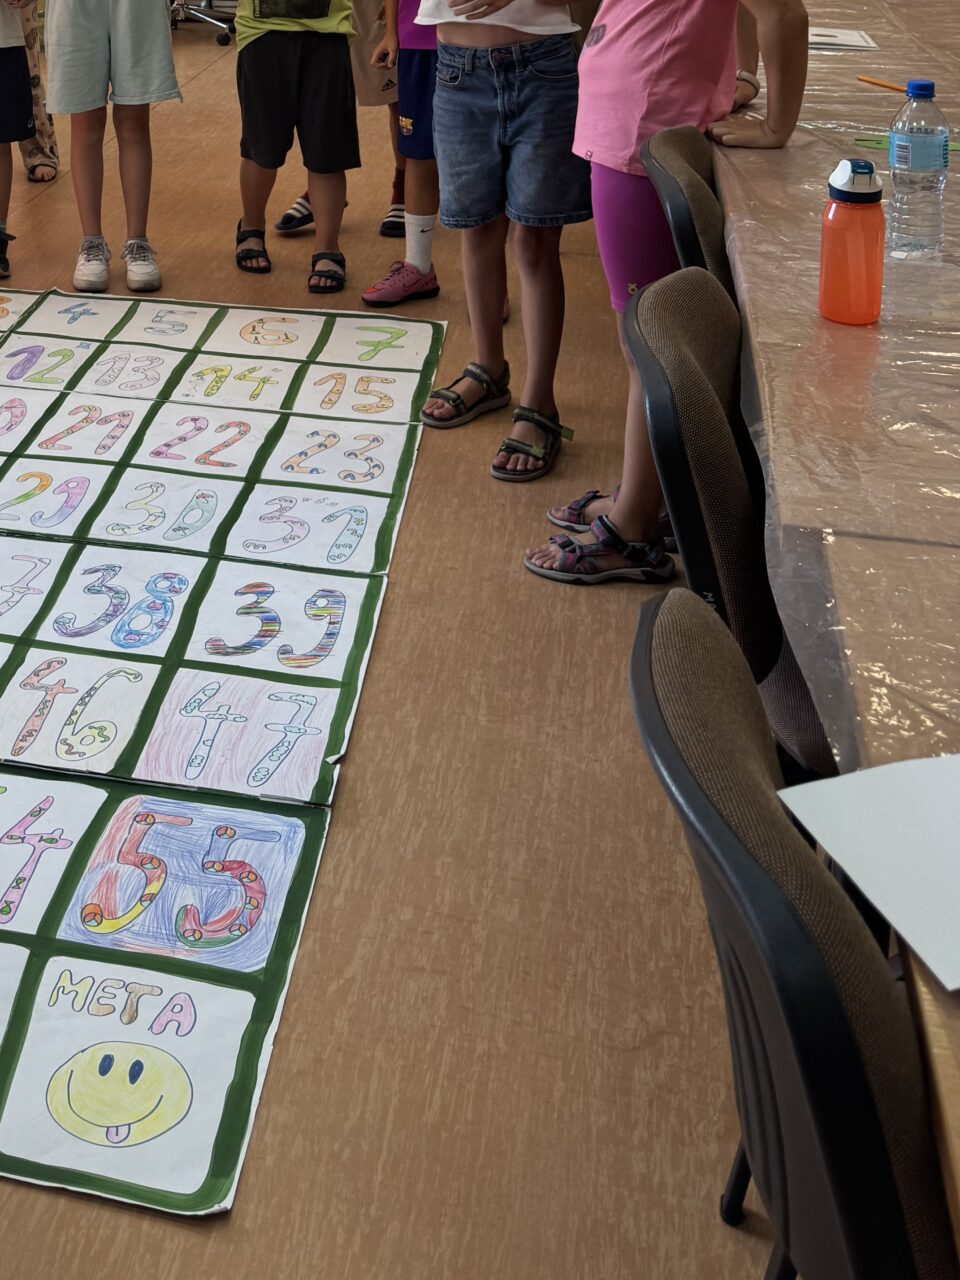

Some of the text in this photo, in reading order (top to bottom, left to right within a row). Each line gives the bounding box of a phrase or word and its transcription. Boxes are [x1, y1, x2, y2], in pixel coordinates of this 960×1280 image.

[57, 302, 99, 325] 4
[143, 309, 197, 336] 5
[240, 317, 299, 346] 6
[4, 345, 75, 384] 12
[355, 326, 408, 361] 7
[94, 353, 165, 391] 13
[191, 364, 279, 401] 14
[313, 372, 398, 413] 15
[37, 405, 134, 455] 21
[149, 416, 251, 467] 22
[280, 429, 385, 483] 23
[105, 481, 219, 541] 30
[243, 496, 368, 564] 31
[52, 563, 189, 649] 38
[205, 581, 347, 669] 39
[10, 656, 145, 761] 46
[180, 681, 322, 788] 47
[82, 811, 282, 949] 55
[49, 969, 197, 1037] META
